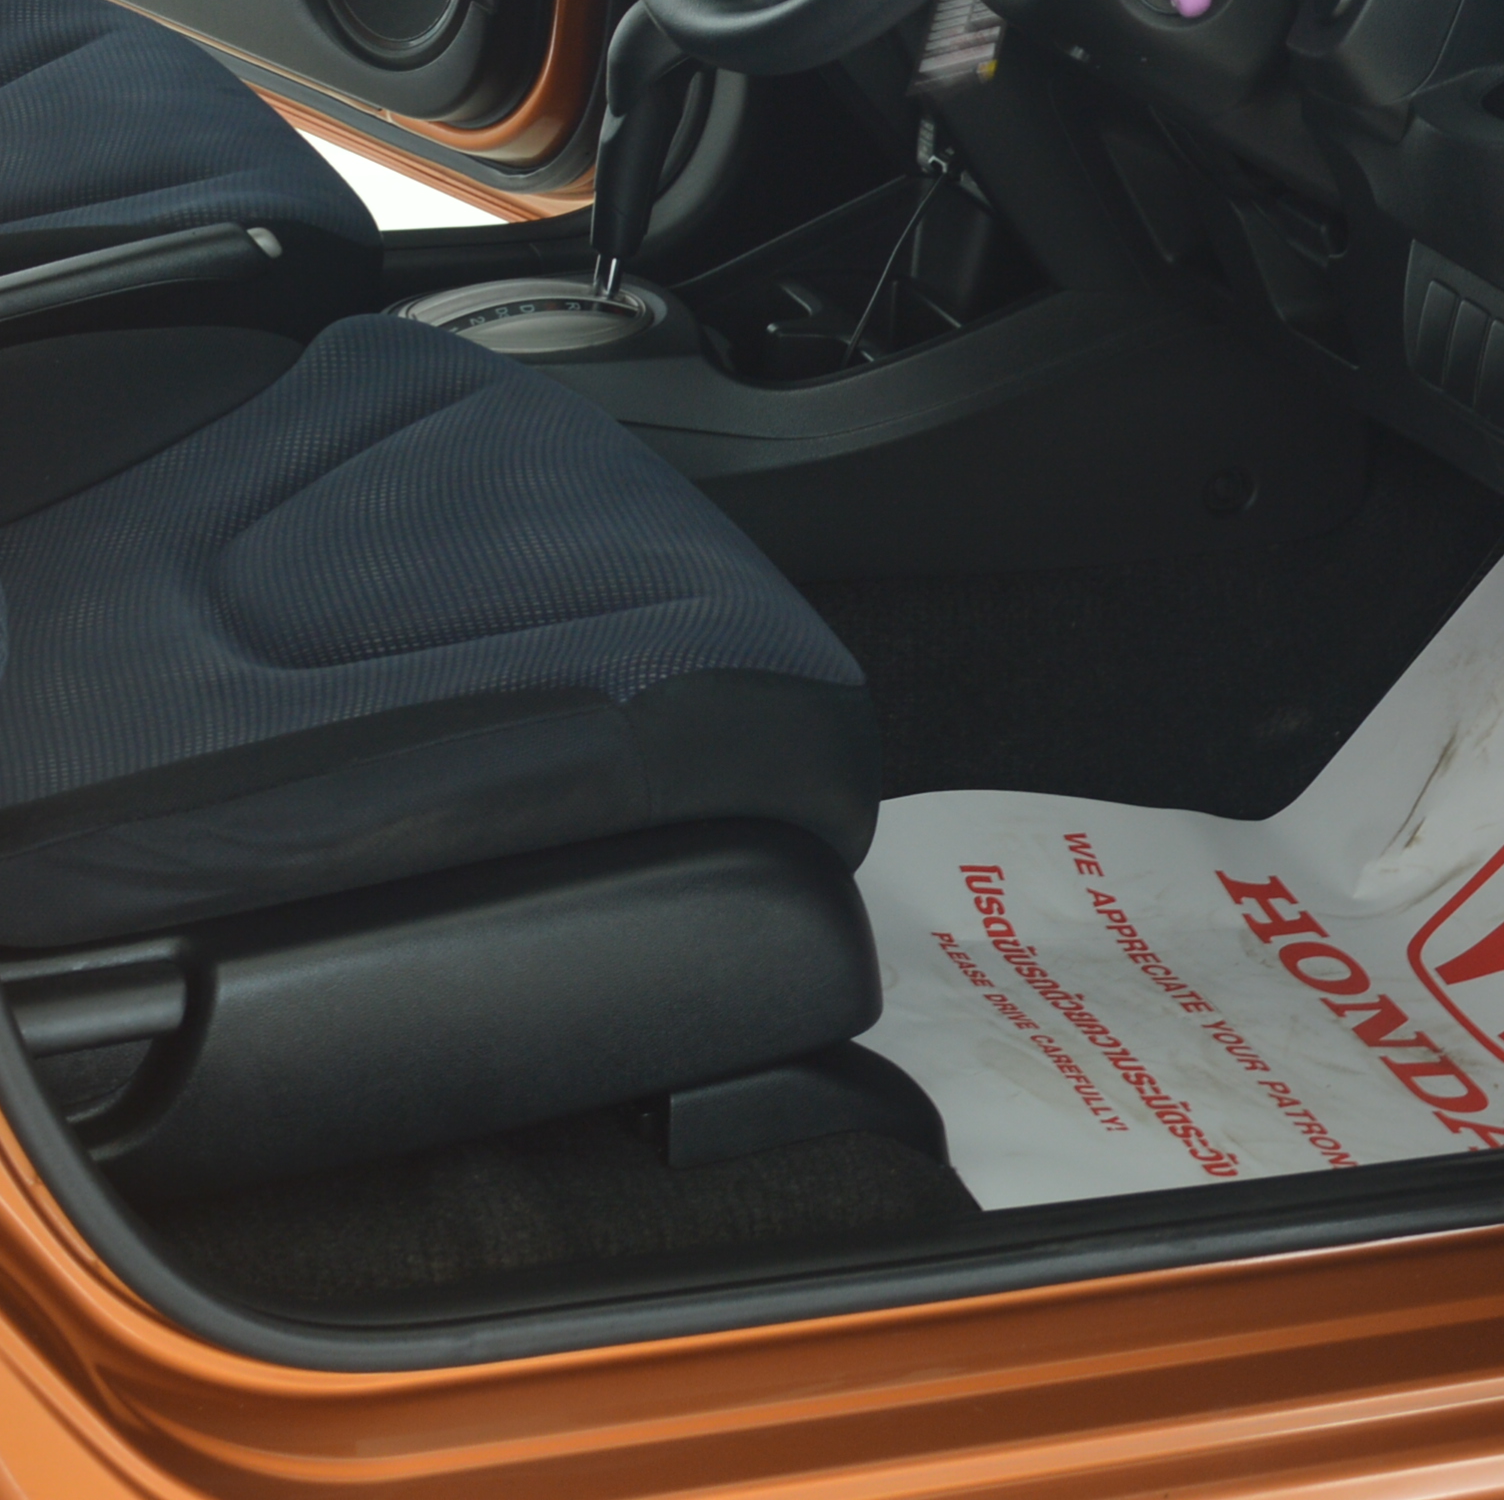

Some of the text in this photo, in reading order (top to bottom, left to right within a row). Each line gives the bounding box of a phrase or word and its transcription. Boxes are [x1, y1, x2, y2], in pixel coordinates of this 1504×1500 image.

[469, 315, 486, 327] 2
[519, 303, 535, 314] D
[931, 931, 1129, 1132] PLEASE DRIVE CAREFULLY!
[1063, 831, 1359, 1169] WE APPRECIATE YOUR PATRON
